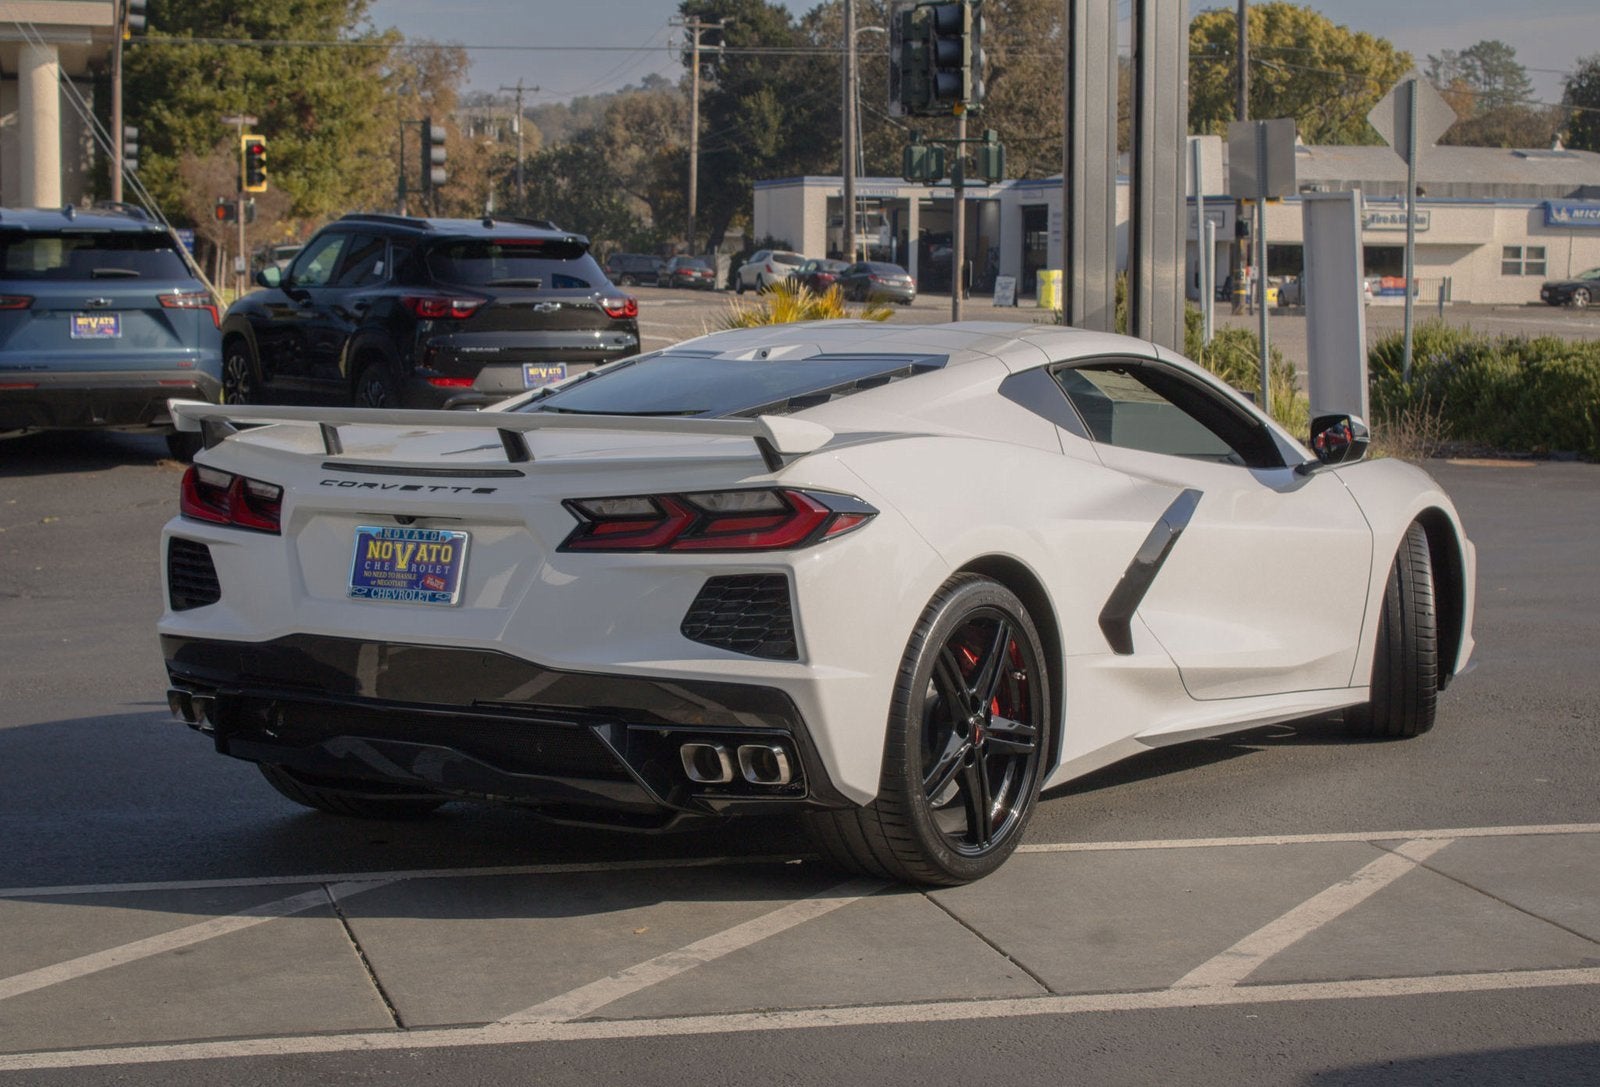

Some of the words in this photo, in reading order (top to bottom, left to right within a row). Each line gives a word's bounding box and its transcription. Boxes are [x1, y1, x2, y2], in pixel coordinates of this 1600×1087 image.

[319, 479, 498, 494] CORVETTE
[384, 529, 438, 540] NOVATO
[366, 541, 453, 569] NOVATO
[371, 588, 432, 602] CHEVROLET
